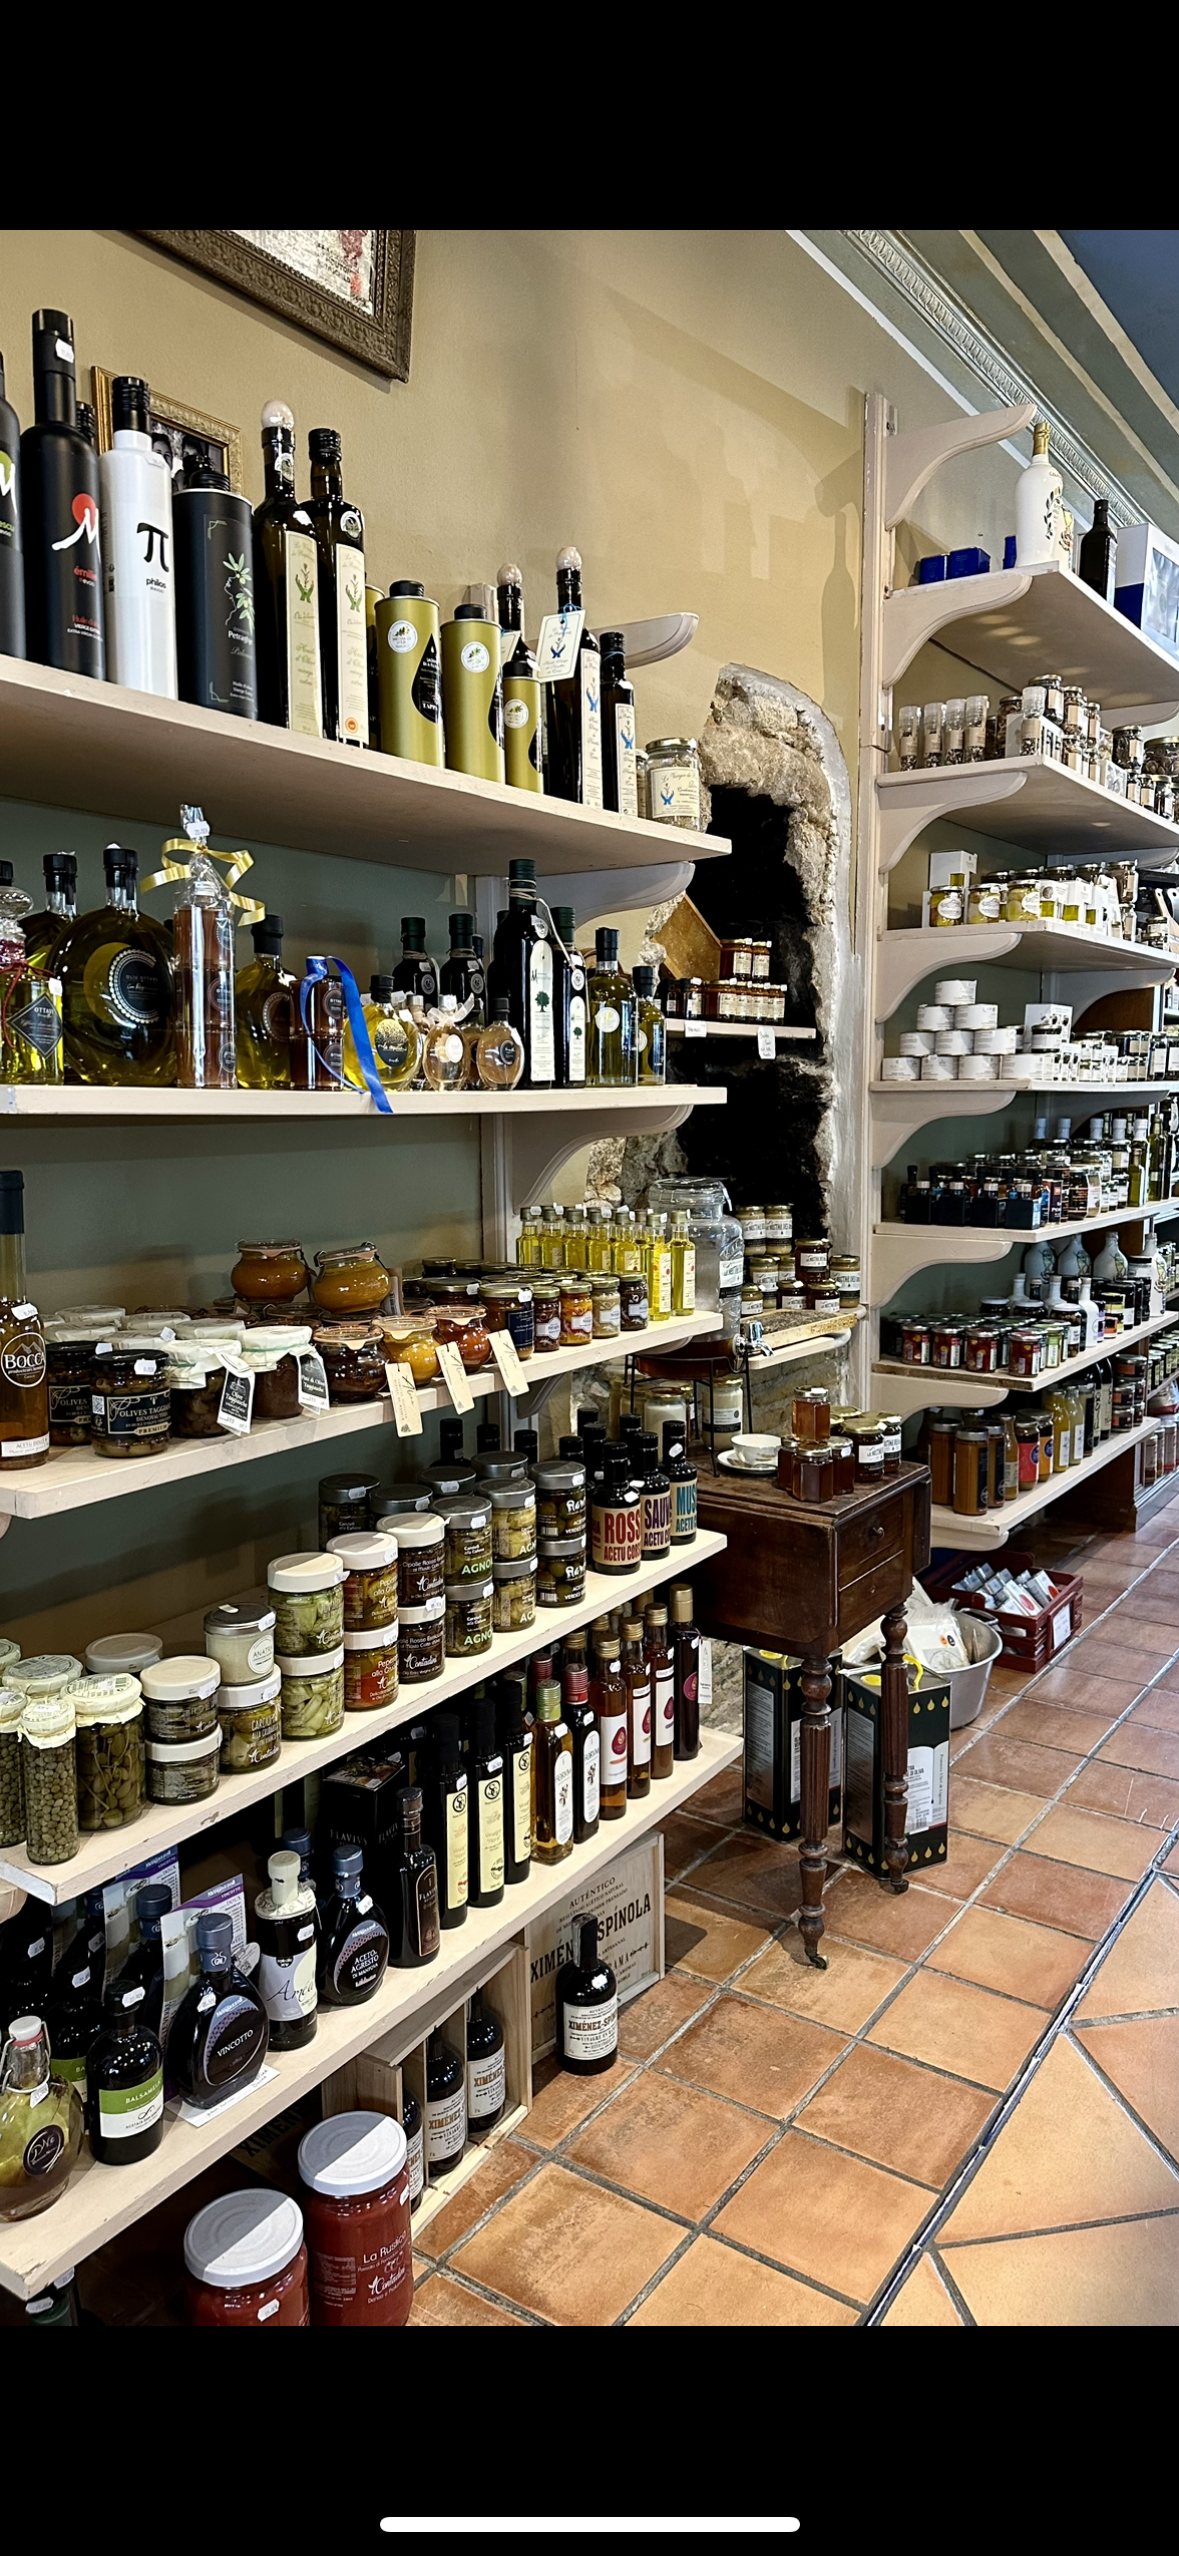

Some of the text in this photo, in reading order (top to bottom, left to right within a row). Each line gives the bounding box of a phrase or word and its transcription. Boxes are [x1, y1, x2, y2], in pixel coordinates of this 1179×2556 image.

[146, 578, 166, 588] philos
[61, 1398, 87, 1406] OLIVES
[119, 1408, 148, 1418] OLIVES
[138, 1425, 168, 1434] PREMIUM
[676, 1482, 697, 1516] MUS
[644, 1494, 672, 1530] SAUV
[604, 1509, 641, 1545] ROSS
[644, 1530, 664, 1546] ACETU
[604, 1543, 641, 1561] ACETU CORS
[461, 1557, 493, 1575] AGNO
[520, 1610, 535, 1624] AG
[464, 1627, 492, 1646] AGNO
[569, 1877, 616, 1909] AUTÉNTICO
[530, 1893, 651, 1984] XIMÉN SPÍNOLA
[351, 1954, 379, 1974] AGRESTO
[355, 1949, 377, 1966] ACETO
[358, 1963, 379, 1978] MANTOVA
[216, 2028, 254, 2057] VINCOTTO
[474, 2067, 505, 2087] XIMÉNEZ
[363, 2253, 377, 2264] La
